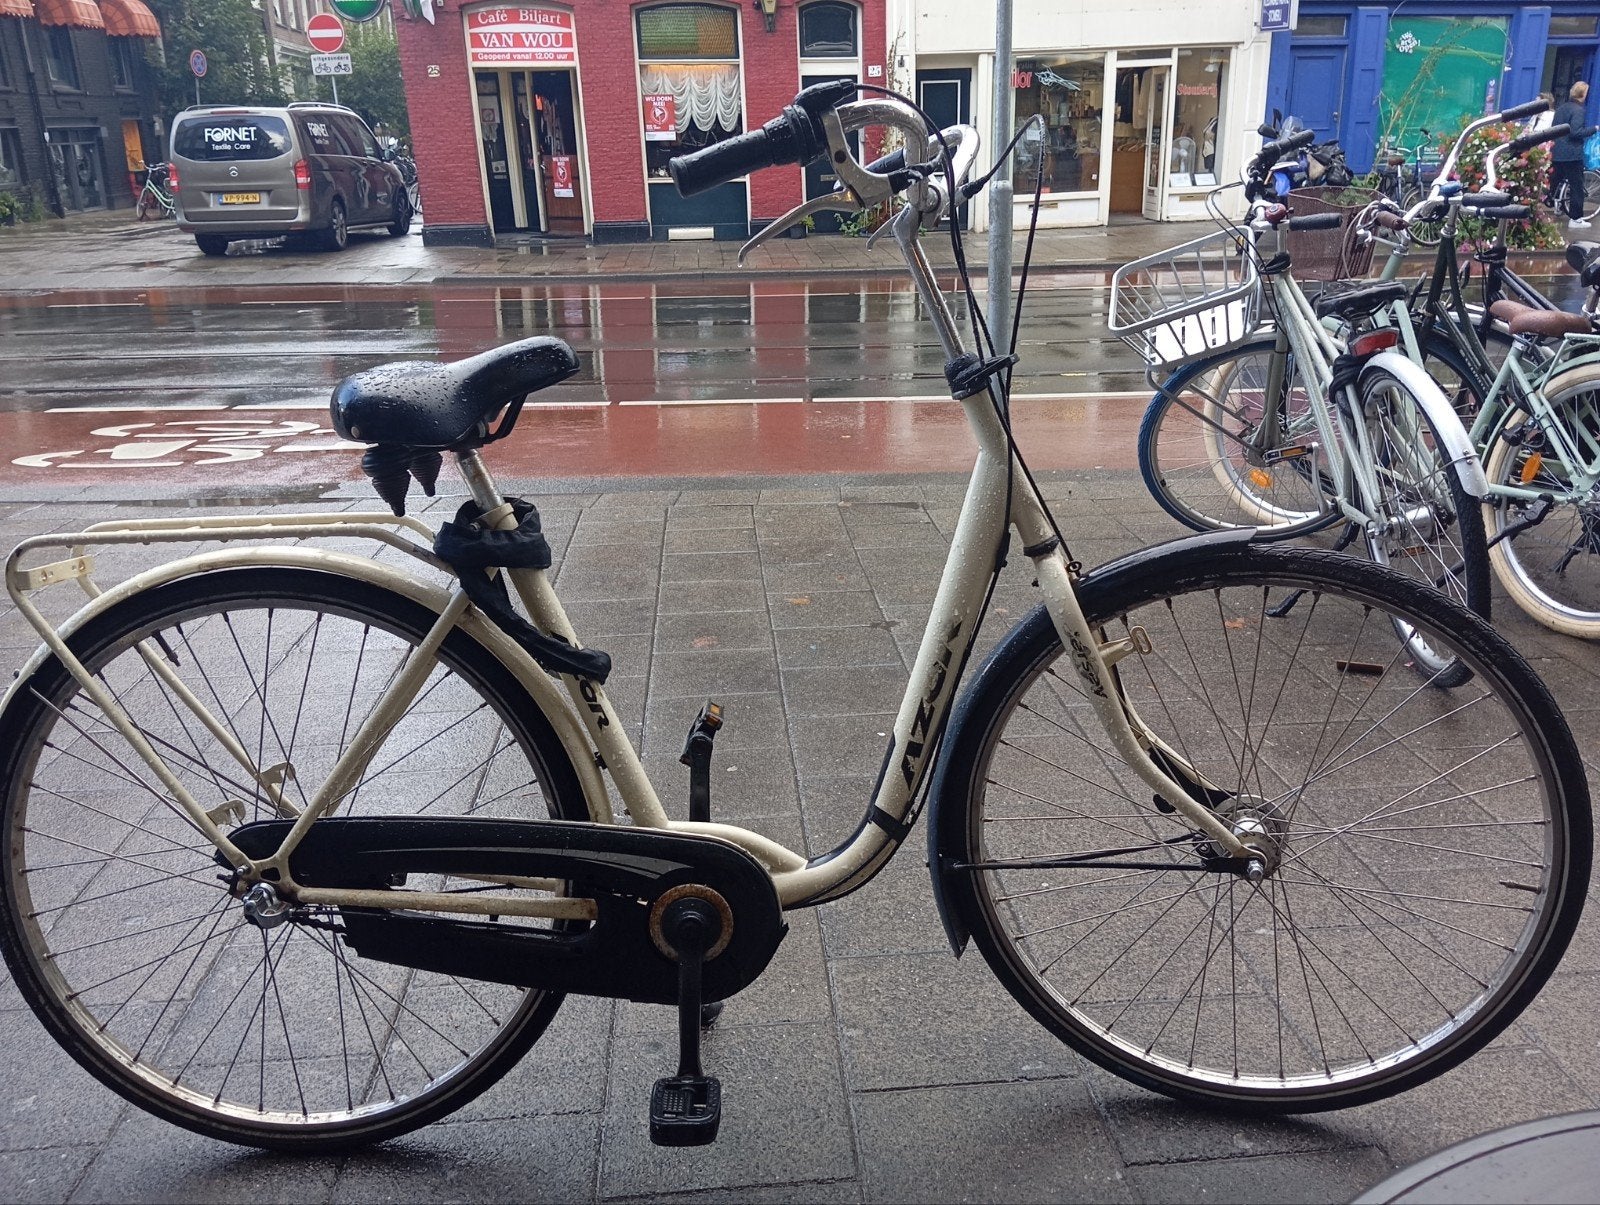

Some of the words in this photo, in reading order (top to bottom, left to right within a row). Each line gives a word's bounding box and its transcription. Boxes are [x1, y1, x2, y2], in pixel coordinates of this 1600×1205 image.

[478, 10, 508, 24] Café
[519, 10, 561, 25] Biljart
[478, 33, 513, 48] VAN
[521, 33, 563, 48] WOU
[478, 53, 510, 61] Geopend
[427, 66, 440, 75] 25
[1011, 68, 1033, 89] ilor
[204, 127, 257, 142] FORNET
[212, 143, 232, 151] Textile
